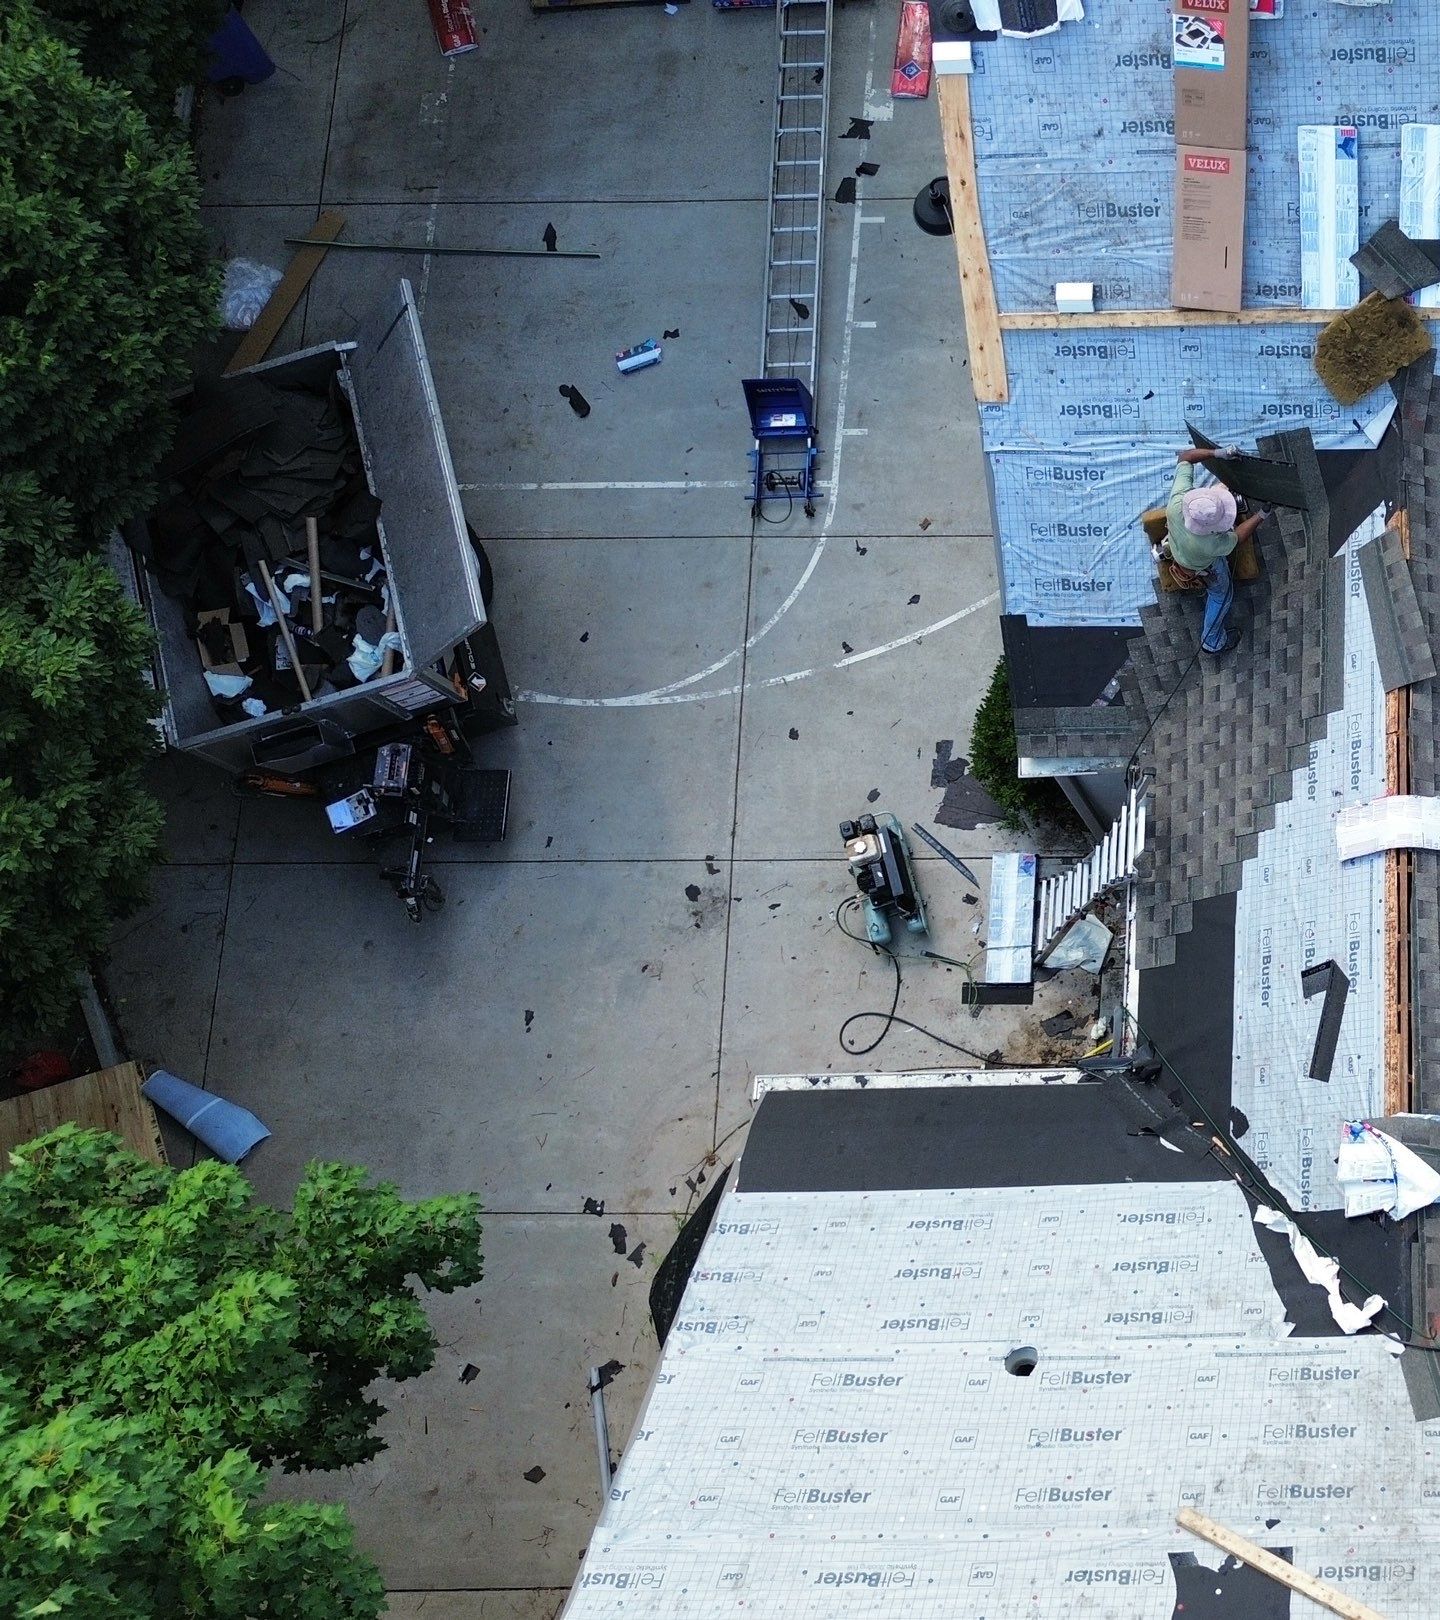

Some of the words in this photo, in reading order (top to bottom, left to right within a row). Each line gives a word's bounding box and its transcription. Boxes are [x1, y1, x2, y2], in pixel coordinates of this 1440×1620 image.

[1330, 45, 1416, 62] FeltBuster
[1188, 158, 1226, 170] VELUX
[1077, 202, 1160, 218] FeltBuster
[1055, 343, 1135, 358] FeltBuster
[1060, 402, 1139, 417] FeltBuster
[1261, 402, 1341, 418] FeltBuster
[1026, 467, 1105, 482] FeltBuster
[1030, 522, 1109, 538] FeltBuster
[1034, 578, 1112, 594] FeltBuster
[1350, 713, 1362, 792] FeltBuster
[1262, 928, 1272, 1008] FeltBuster
[907, 1217, 993, 1231] FeltBuster
[894, 1266, 982, 1280] FeltBuster
[1113, 1260, 1199, 1274] FeltBuster
[881, 1317, 970, 1330] FeltBuster
[1105, 1310, 1193, 1323] FeltBuster
[811, 1373, 903, 1387] FeltBuster
[1039, 1371, 1132, 1386] FeltBuster
[1269, 1367, 1361, 1382] FeltBuster
[794, 1429, 888, 1444] FeltBuster
[1028, 1428, 1122, 1442] FeltBuster
[1263, 1424, 1357, 1439] FeltBuster
[773, 1488, 871, 1504] FeltBuster
[1016, 1487, 1112, 1502] FeltBuster
[1257, 1484, 1353, 1499] FeltBuster
[815, 1570, 915, 1588] FeltBuster
[1066, 1567, 1165, 1585] FeltBuster
[1318, 1565, 1415, 1581] FeltBuster
